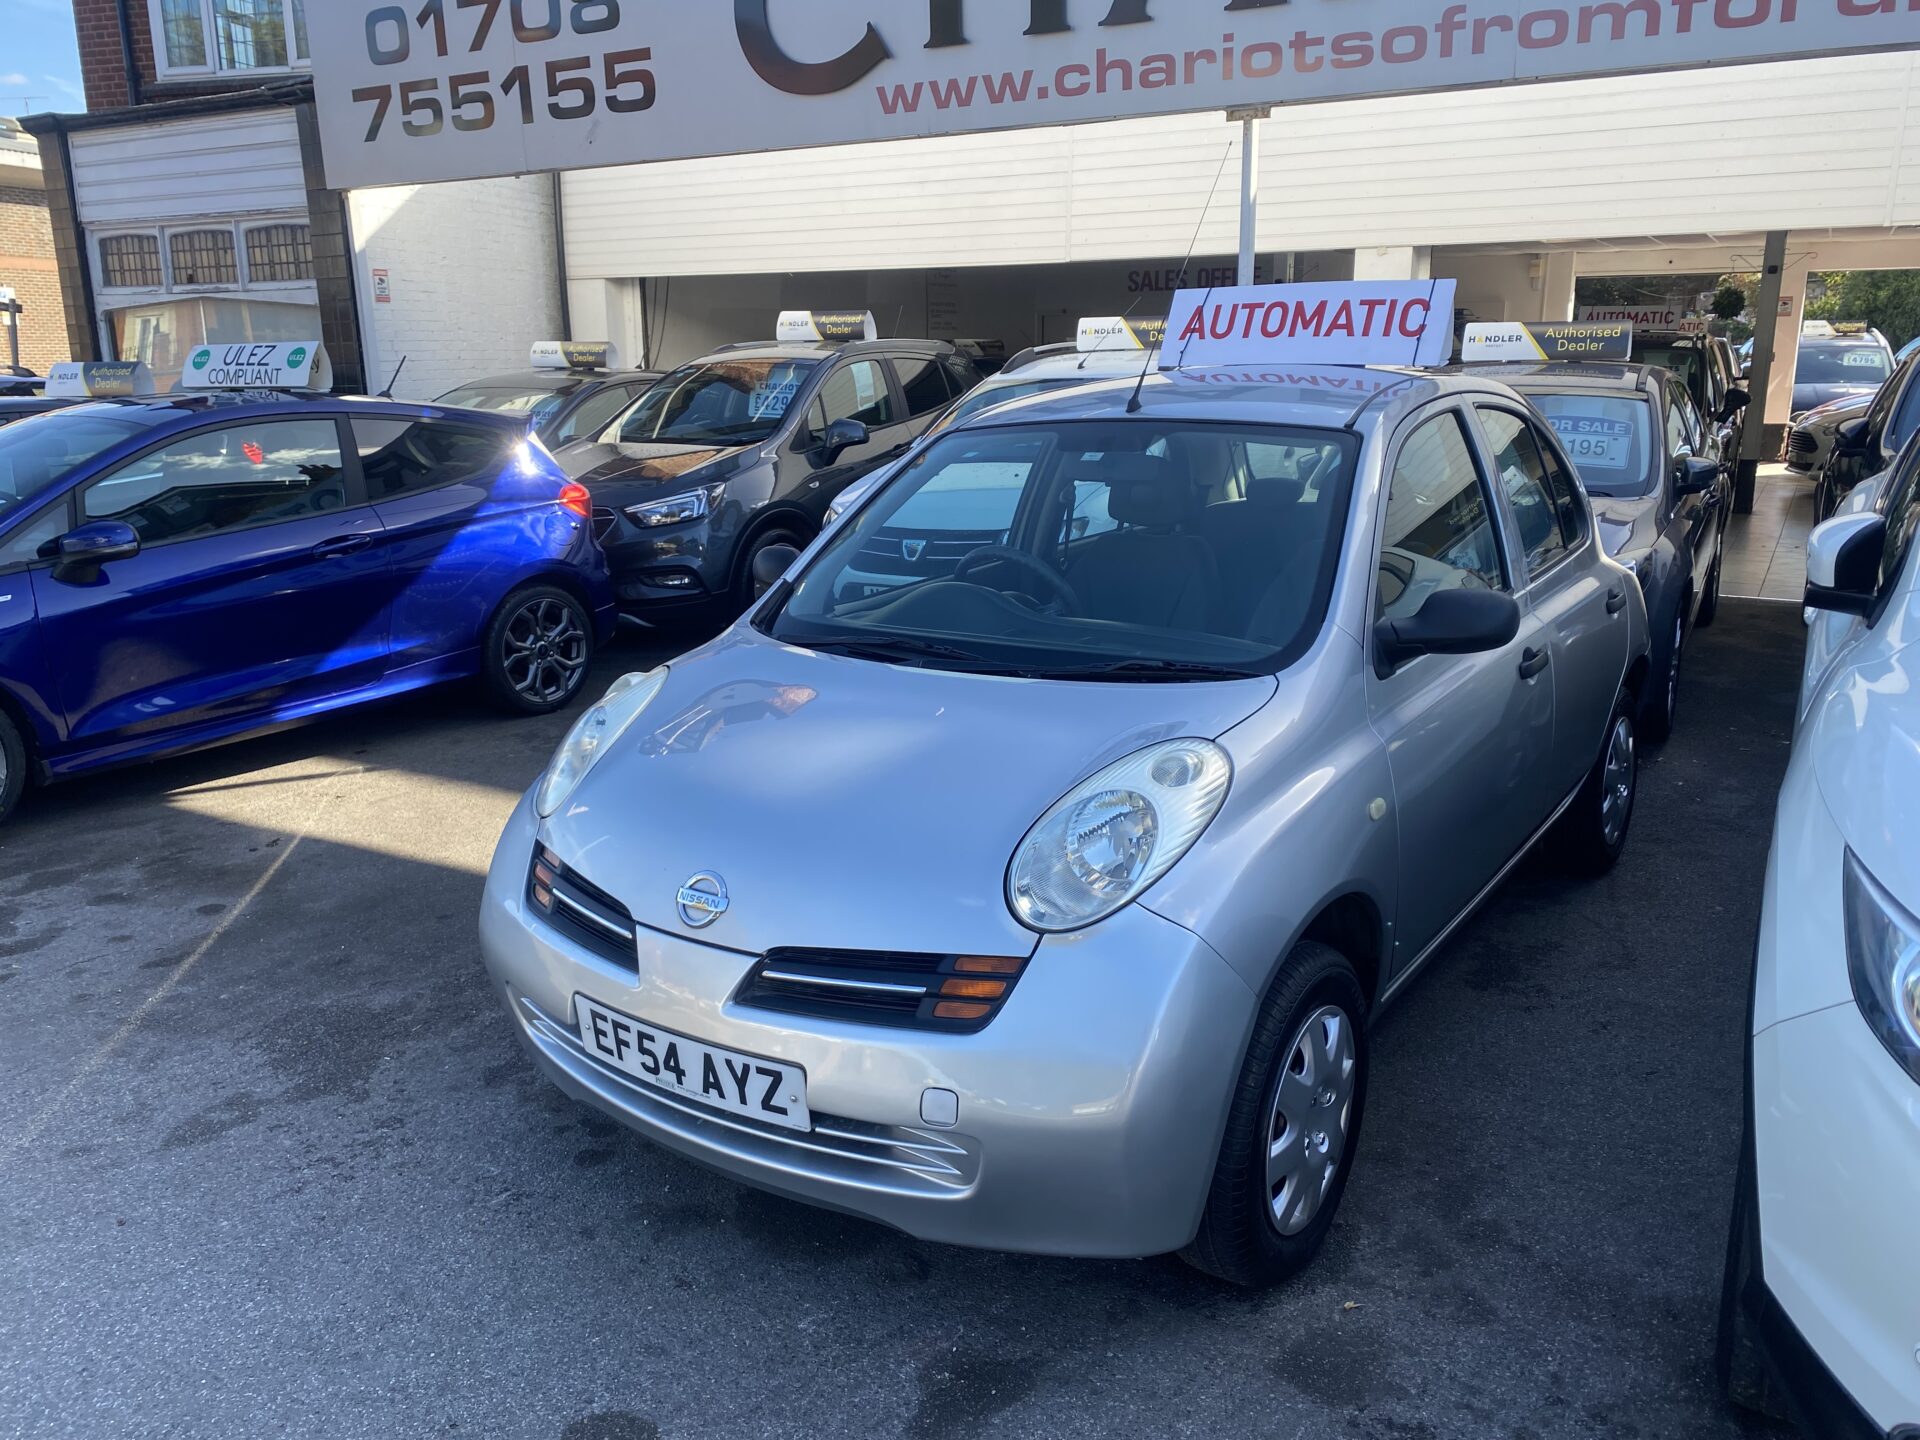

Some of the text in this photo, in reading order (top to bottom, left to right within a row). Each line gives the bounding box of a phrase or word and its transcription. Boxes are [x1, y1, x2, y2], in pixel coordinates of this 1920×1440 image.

[364, 0, 620, 66] 01708
[352, 47, 656, 142] 755155
[1128, 269, 1187, 292] SALES
[820, 314, 862, 324] Authorised
[1178, 297, 1429, 340] AUTOMATIC
[1586, 311, 1675, 324] AUTOMATIC
[826, 324, 852, 334] Dealer
[1545, 326, 1622, 338] Authorised
[1557, 338, 1605, 351] Dealer
[223, 345, 277, 366] ULEZ
[573, 353, 596, 362] Dealer
[90, 365, 133, 376] Authorised
[208, 368, 282, 385] COMPLIANT
[95, 377, 120, 388] Dealer
[1549, 419, 1626, 434] OR SALE
[679, 890, 720, 909] NISSAN
[590, 1008, 788, 1116] EF54 AYZ
